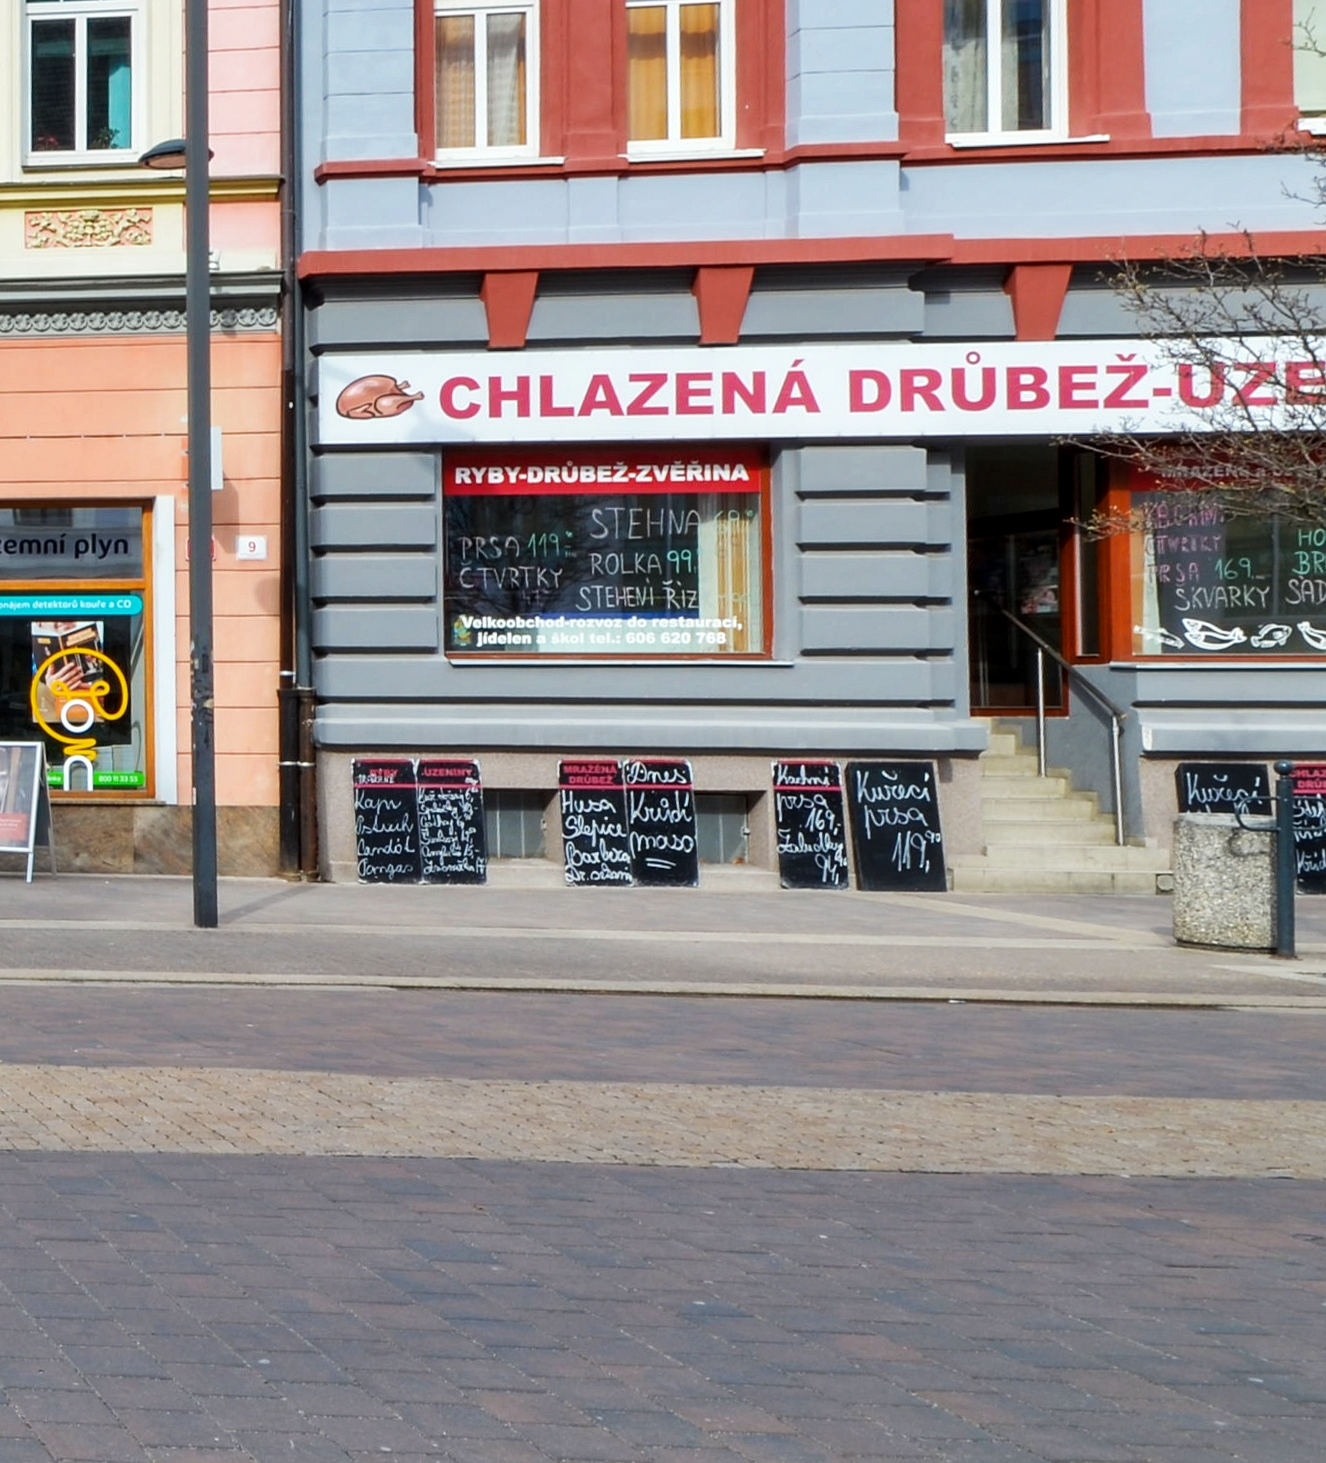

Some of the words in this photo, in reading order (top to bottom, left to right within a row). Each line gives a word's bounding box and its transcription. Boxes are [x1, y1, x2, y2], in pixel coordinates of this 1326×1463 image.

[439, 359, 821, 419] CHLAZENÁ
[454, 460, 750, 484] RYBY-DRŮBEŽ-ZVĚŘINA
[590, 507, 700, 540] STEHNA
[74, 533, 129, 560] plyn
[248, 541, 256, 553] 9
[458, 536, 520, 561] PRSA
[459, 560, 563, 589] ČTVRTKY
[589, 552, 663, 576] ROLKA
[32, 600, 78, 609] detektorů
[79, 599, 106, 608] kouře
[116, 599, 132, 608] CO
[460, 616, 623, 629] Velkoobchod-rozvoz
[627, 616, 647, 628] do
[651, 614, 744, 631] restaurací,
[476, 631, 532, 647] jídelen
[536, 634, 547, 644] a
[552, 630, 585, 644] škol
[626, 631, 656, 644] 606
[660, 631, 692, 644] 620
[695, 630, 728, 644] 768
[423, 767, 474, 776] UZENINY
[561, 789, 617, 814] Husa
[776, 792, 830, 823] prsa
[561, 814, 627, 848] Slepice
[863, 804, 929, 840] prsa
[630, 831, 694, 860] maso
